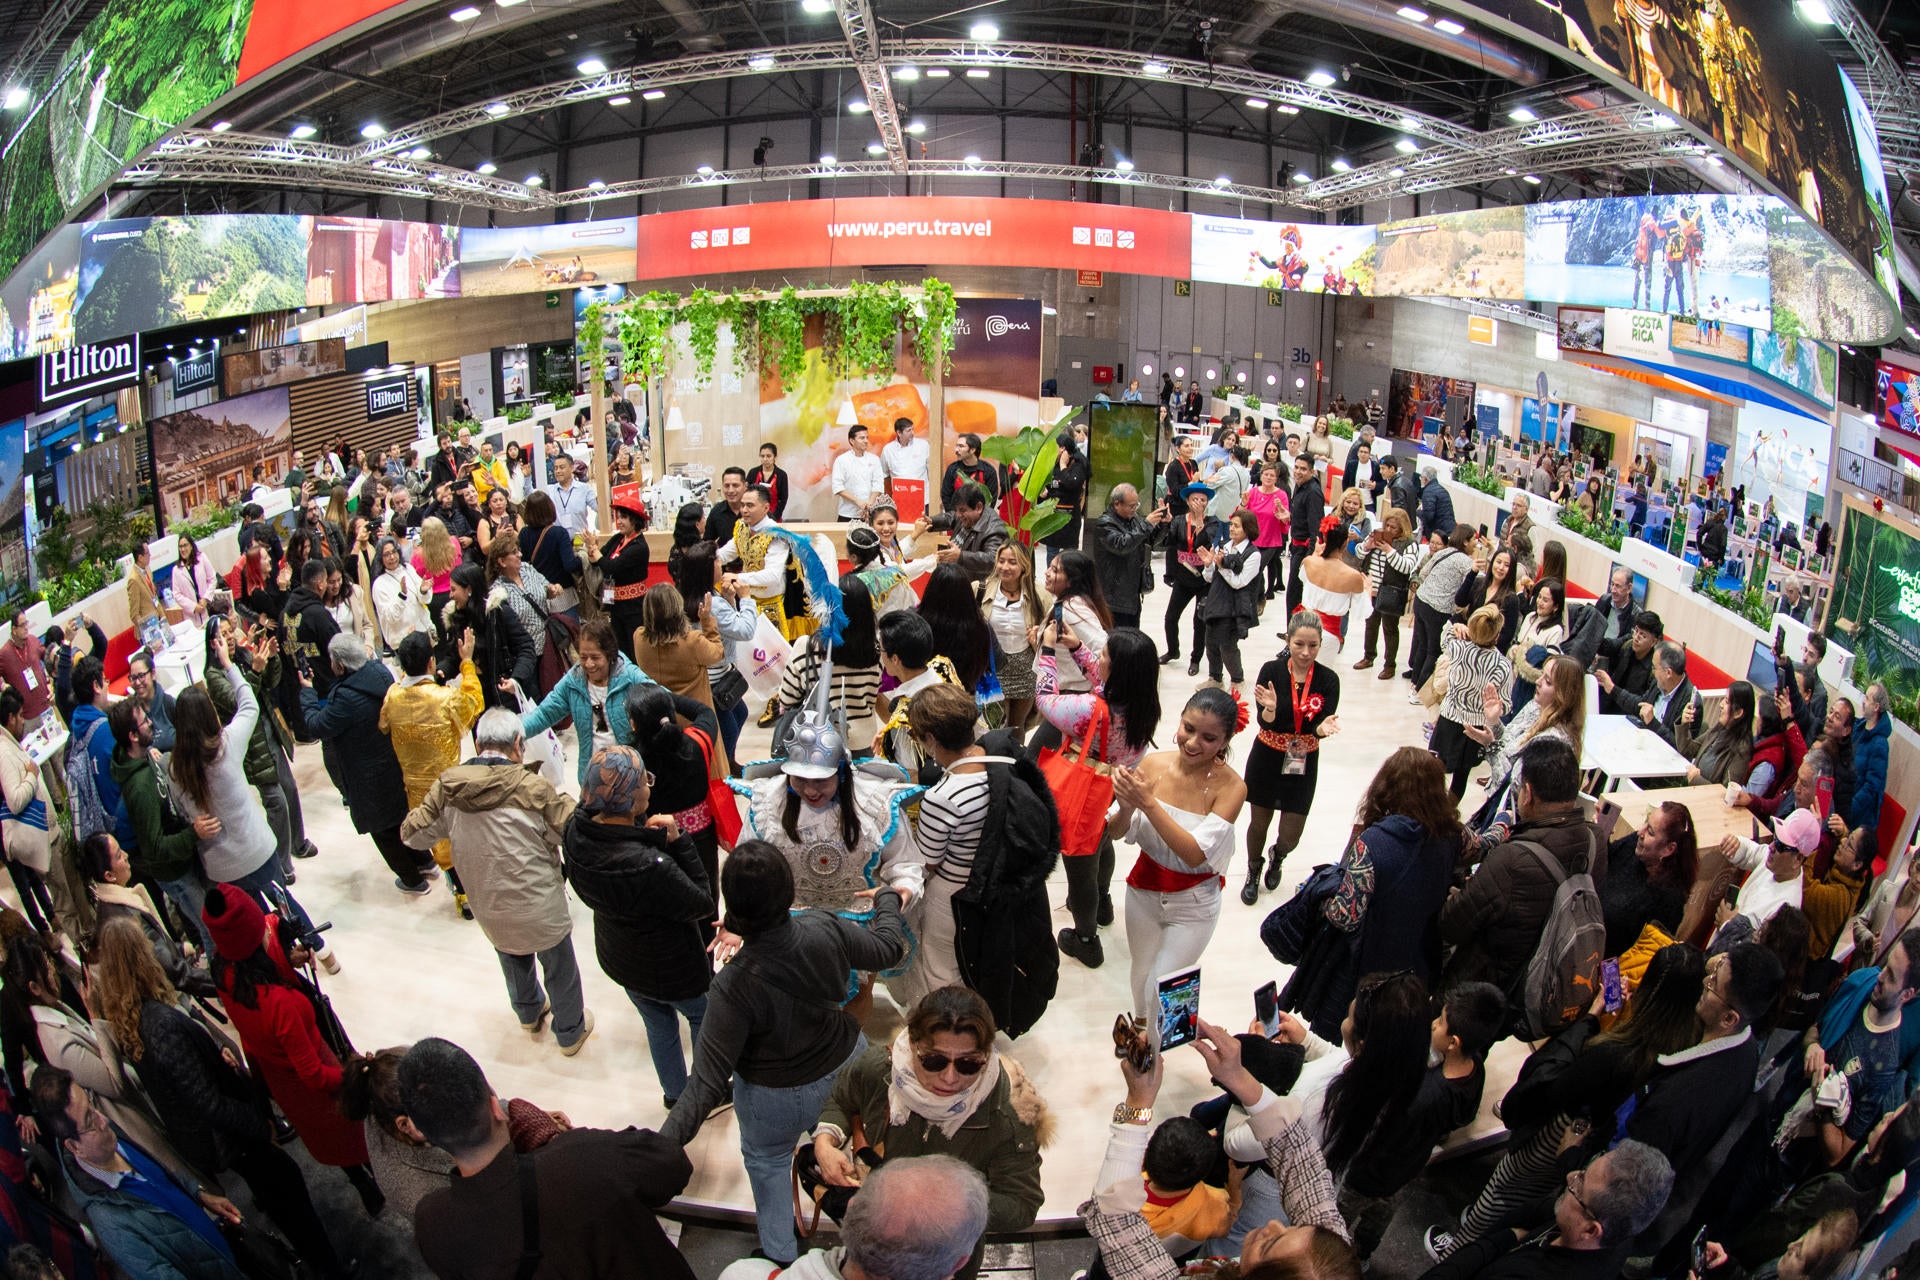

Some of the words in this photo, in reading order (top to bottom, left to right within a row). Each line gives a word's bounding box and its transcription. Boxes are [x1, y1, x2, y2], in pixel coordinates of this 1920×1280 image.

[827, 219, 991, 238] www.peru.travel
[985, 315, 1030, 341] Perú
[1632, 315, 1663, 331] COSTA
[1632, 328, 1654, 344] RICA
[50, 343, 131, 386] Hilton
[1292, 347, 1311, 364] 3b
[178, 362, 212, 385] Hilton
[372, 390, 404, 409] Hilton
[1869, 617, 1900, 642] #CostaRica
